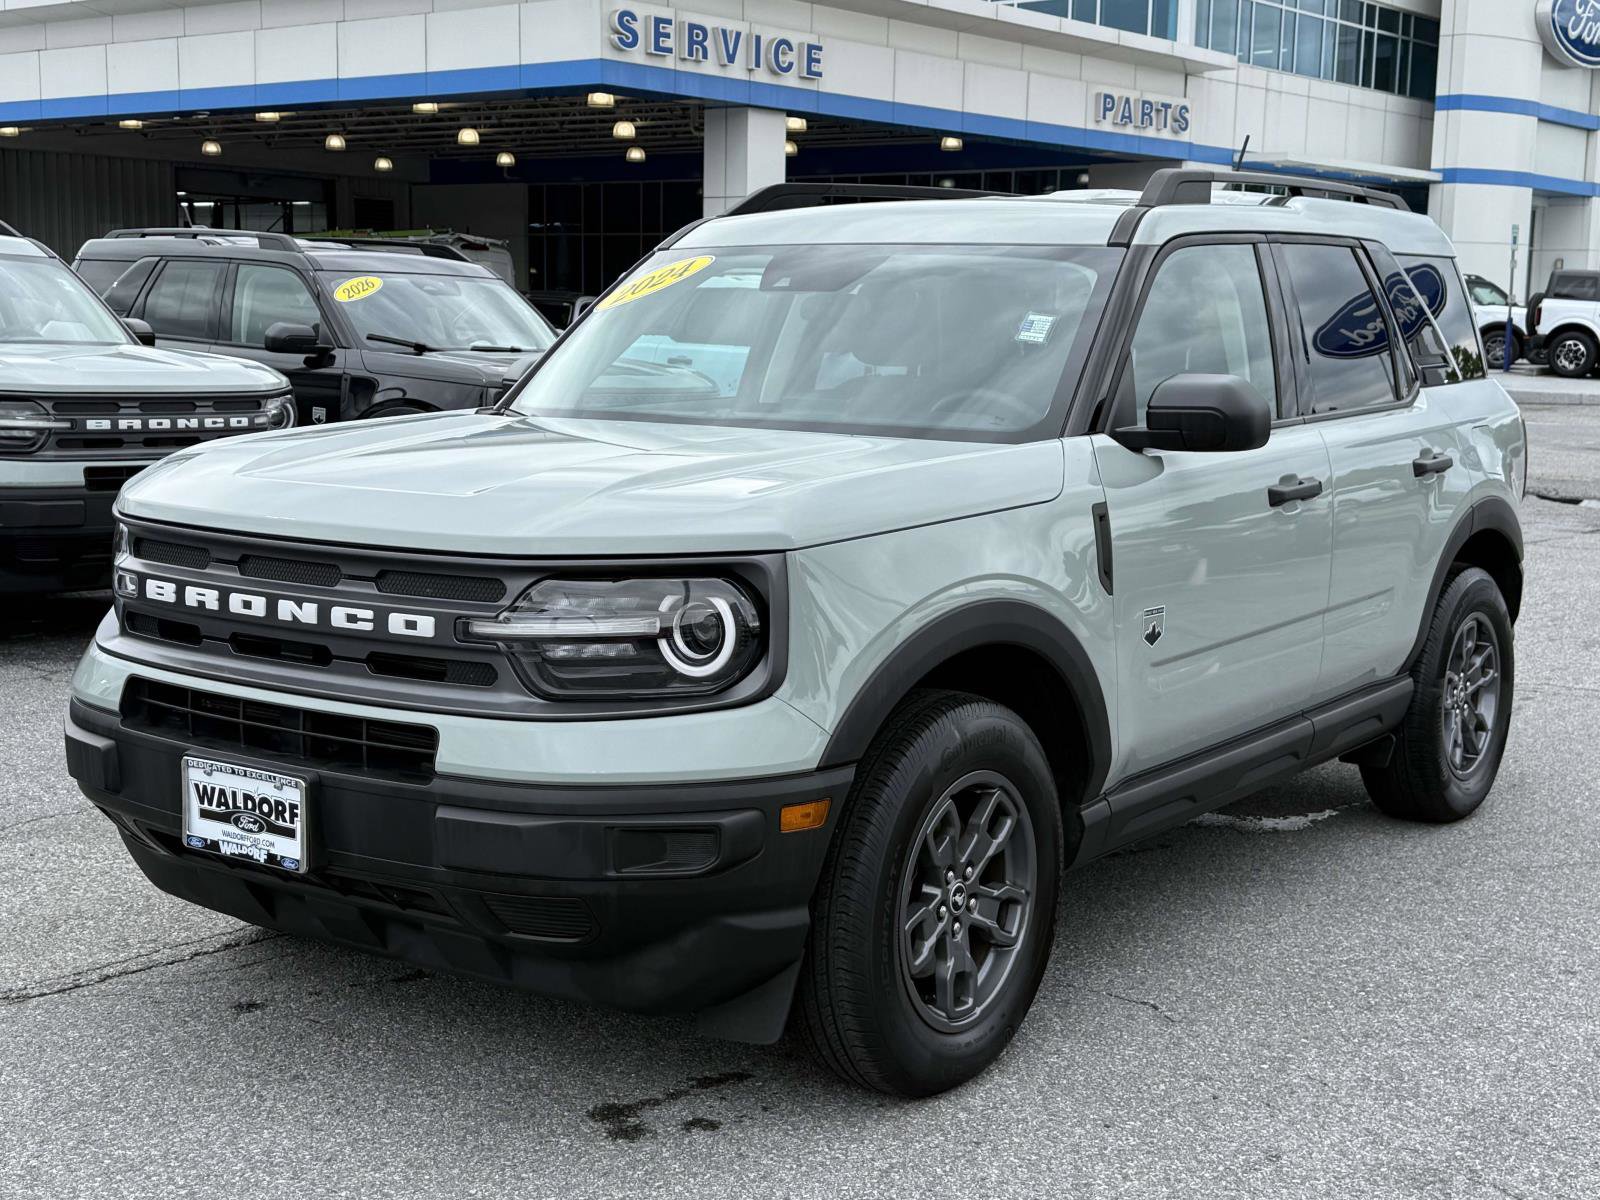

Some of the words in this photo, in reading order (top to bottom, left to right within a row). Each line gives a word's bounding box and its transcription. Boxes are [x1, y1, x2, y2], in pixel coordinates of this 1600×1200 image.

[610, 9, 823, 77] SERVICE
[1097, 92, 1190, 133] PARTS
[342, 278, 375, 299] 2026
[608, 259, 697, 306] 2024
[86, 417, 249, 430] BRONCO
[145, 578, 436, 638] BRONCO
[188, 759, 232, 774] DEDICATED
[235, 768, 245, 776] TO
[246, 770, 297, 788] EXCELLENCE
[193, 783, 299, 825] WALDORF
[238, 815, 260, 832] Ford
[219, 840, 268, 864] WALDORF
[222, 829, 276, 849] WALDORFFORD.COM
